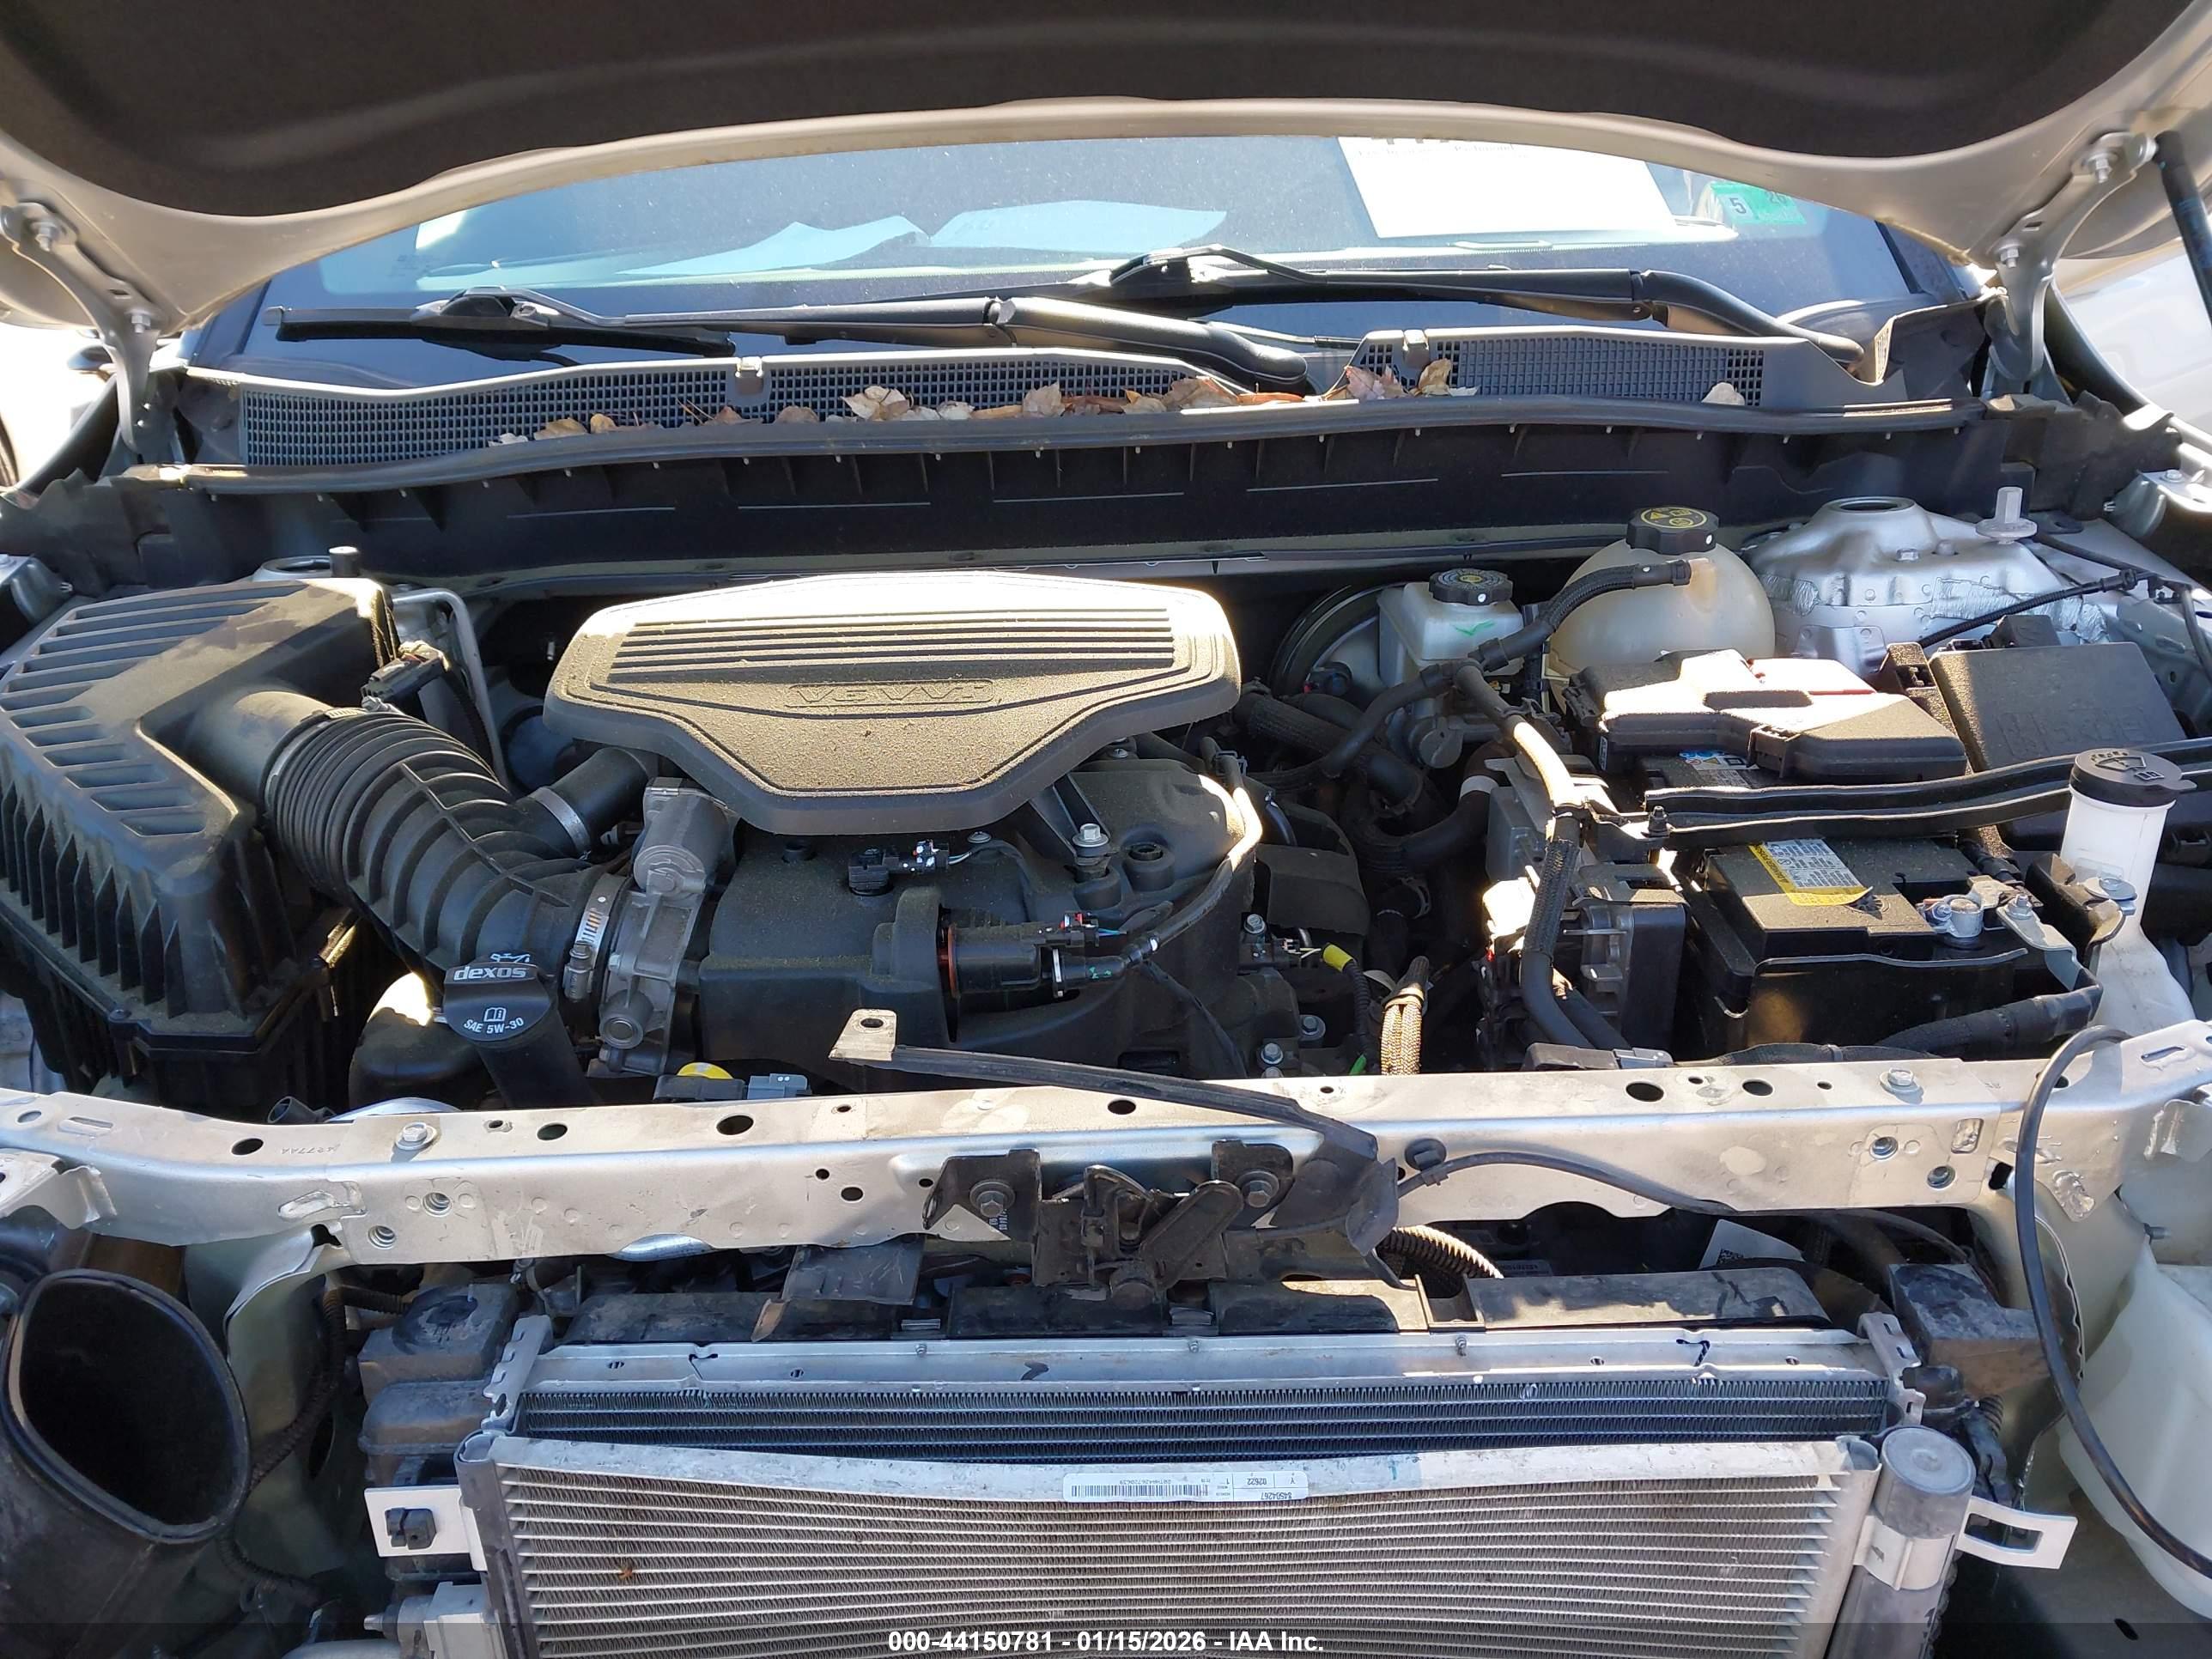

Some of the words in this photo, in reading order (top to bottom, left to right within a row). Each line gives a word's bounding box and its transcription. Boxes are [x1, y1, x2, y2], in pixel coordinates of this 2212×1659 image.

[1729, 198, 1747, 215] 5
[453, 966, 527, 981] dexos
[464, 1018, 483, 1033] SAE
[486, 1017, 524, 1034] 5W-30
